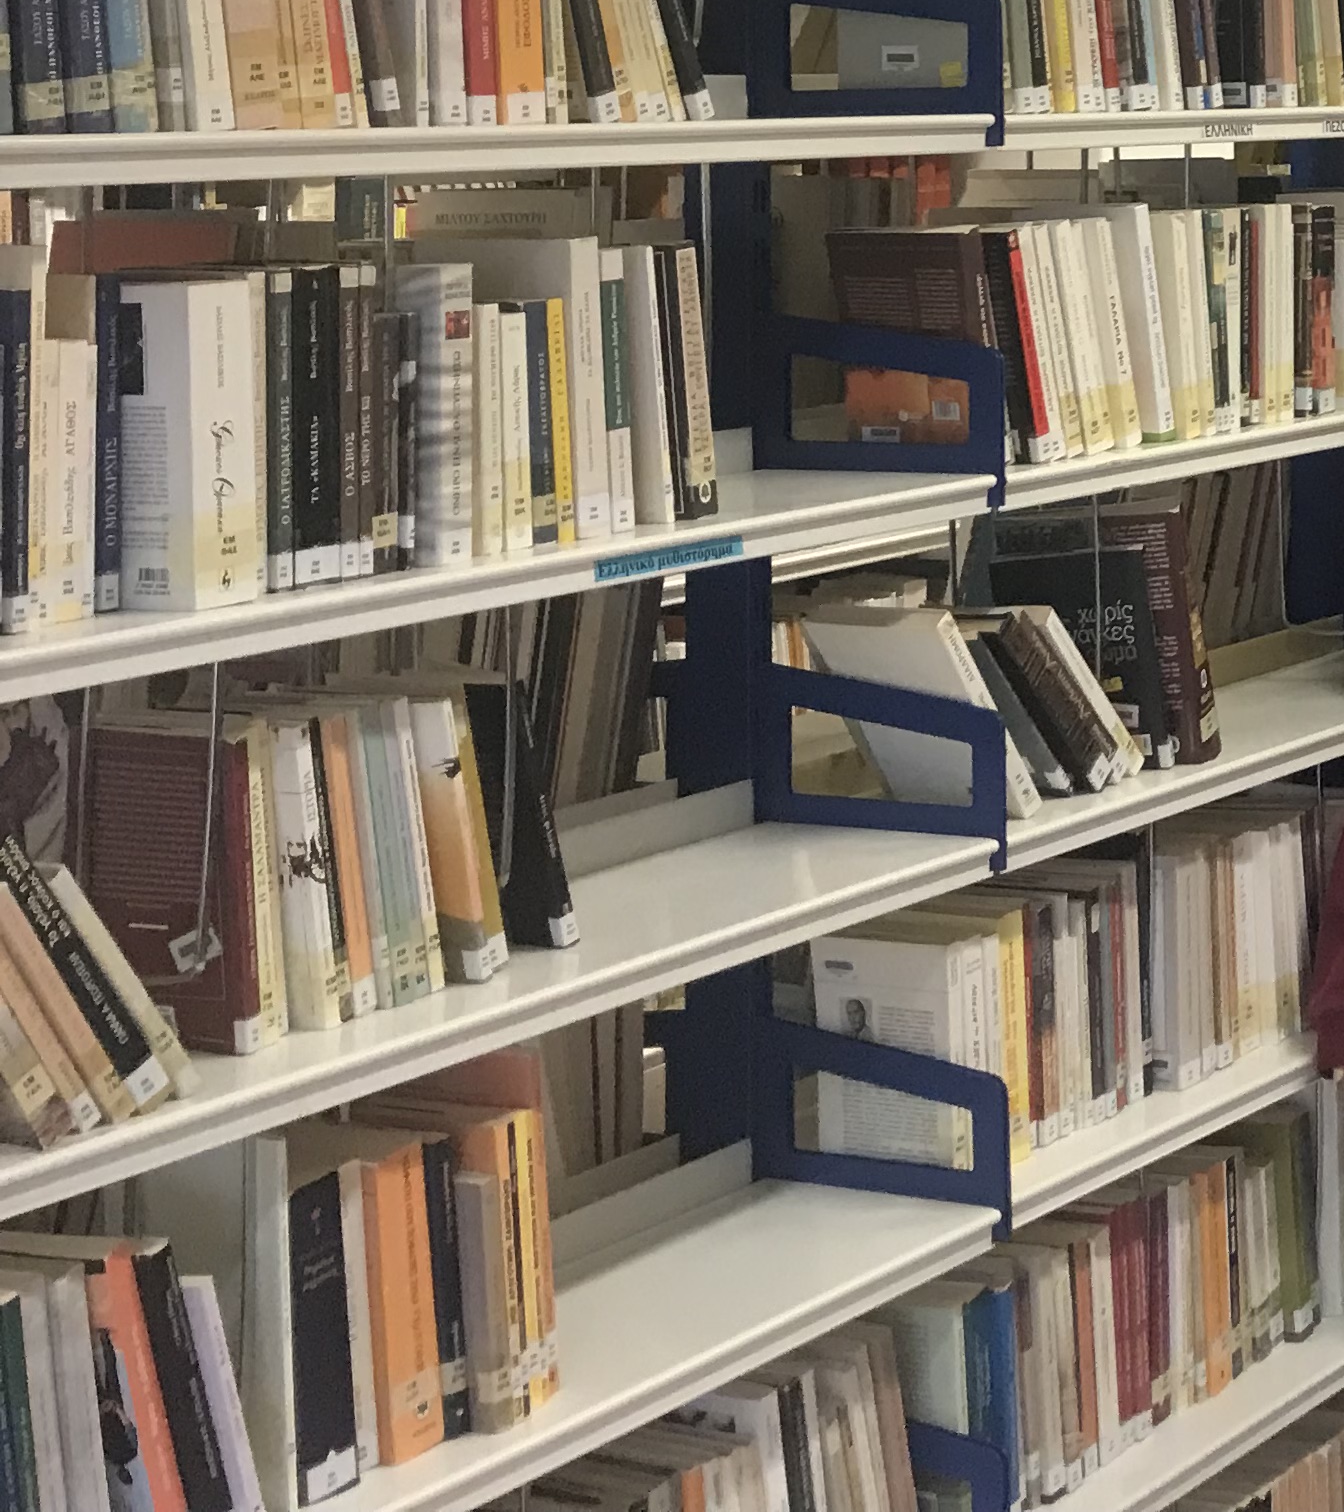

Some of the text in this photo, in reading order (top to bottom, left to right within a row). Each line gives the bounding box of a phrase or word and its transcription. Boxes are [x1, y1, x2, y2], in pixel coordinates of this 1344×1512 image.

[1204, 124, 1254, 138] ΕΛΛΗΝΙΚΗ
[483, 211, 547, 225] ΣΑΧΤΟΥΡΗ
[65, 401, 76, 456] ΑΓΑΘΟΣ
[279, 395, 291, 510] ΙΑΤΡΟΔΙΚΑΣΤΗΣ
[344, 431, 356, 481] ΑΣΒΟΣ
[105, 436, 118, 529] ΜΟΝΑΡΧΗΣ
[361, 470, 371, 485] ΤΟ
[310, 486, 320, 504] ΤΑ
[345, 486, 355, 496] Ο
[280, 515, 290, 525] Ο
[105, 534, 116, 546] Ο
[597, 544, 733, 578] Ελληνικό μυθιστόρημα
[250, 780, 265, 888] ΣΑΛΑΜΑΝΤΡΑ
